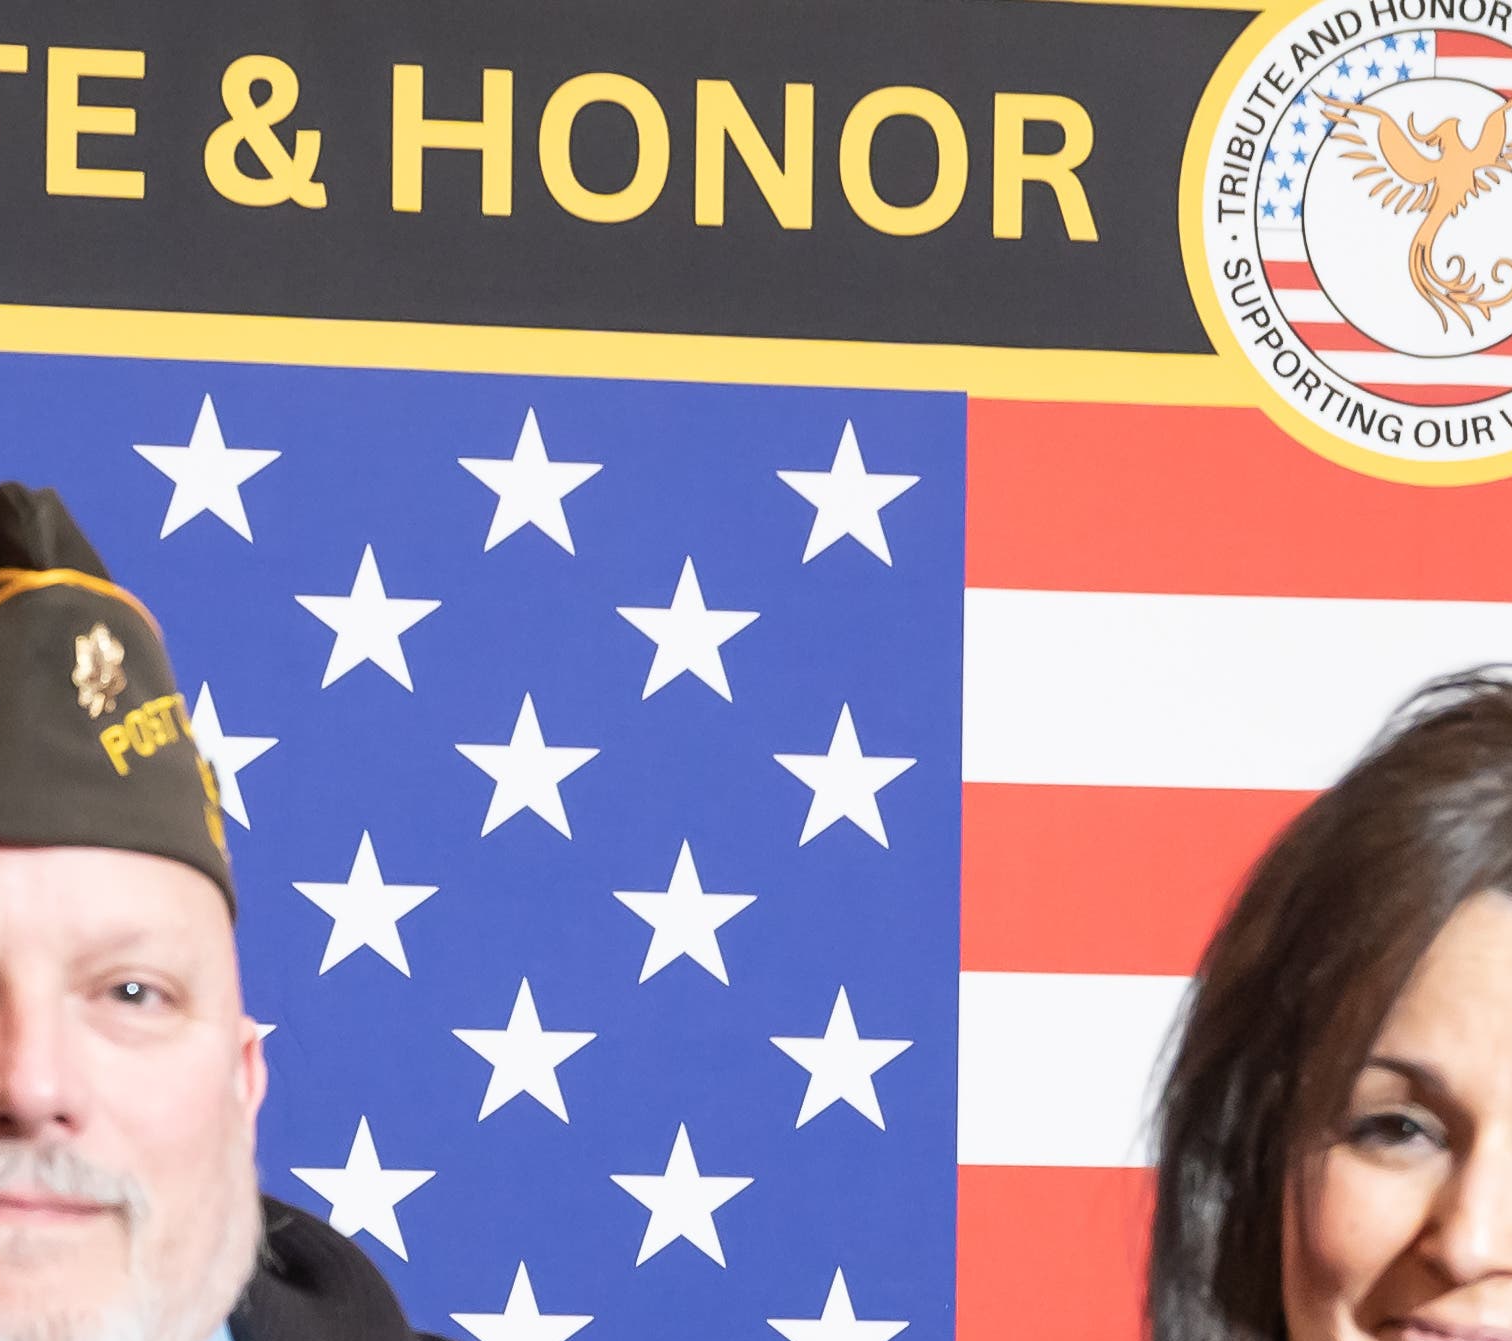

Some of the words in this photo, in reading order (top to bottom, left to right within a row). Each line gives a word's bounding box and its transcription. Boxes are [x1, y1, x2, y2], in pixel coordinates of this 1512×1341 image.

[203, 54, 327, 209] &
[391, 63, 1099, 242] HONOR
[1218, 65, 1292, 223] TRIBUTE
[1290, 9, 1362, 72] AND
[1370, 0, 1512, 33] HONOR
[1223, 256, 1403, 444] SUPPORTING
[1413, 415, 1496, 448] OUR
[99, 694, 180, 776] POST
